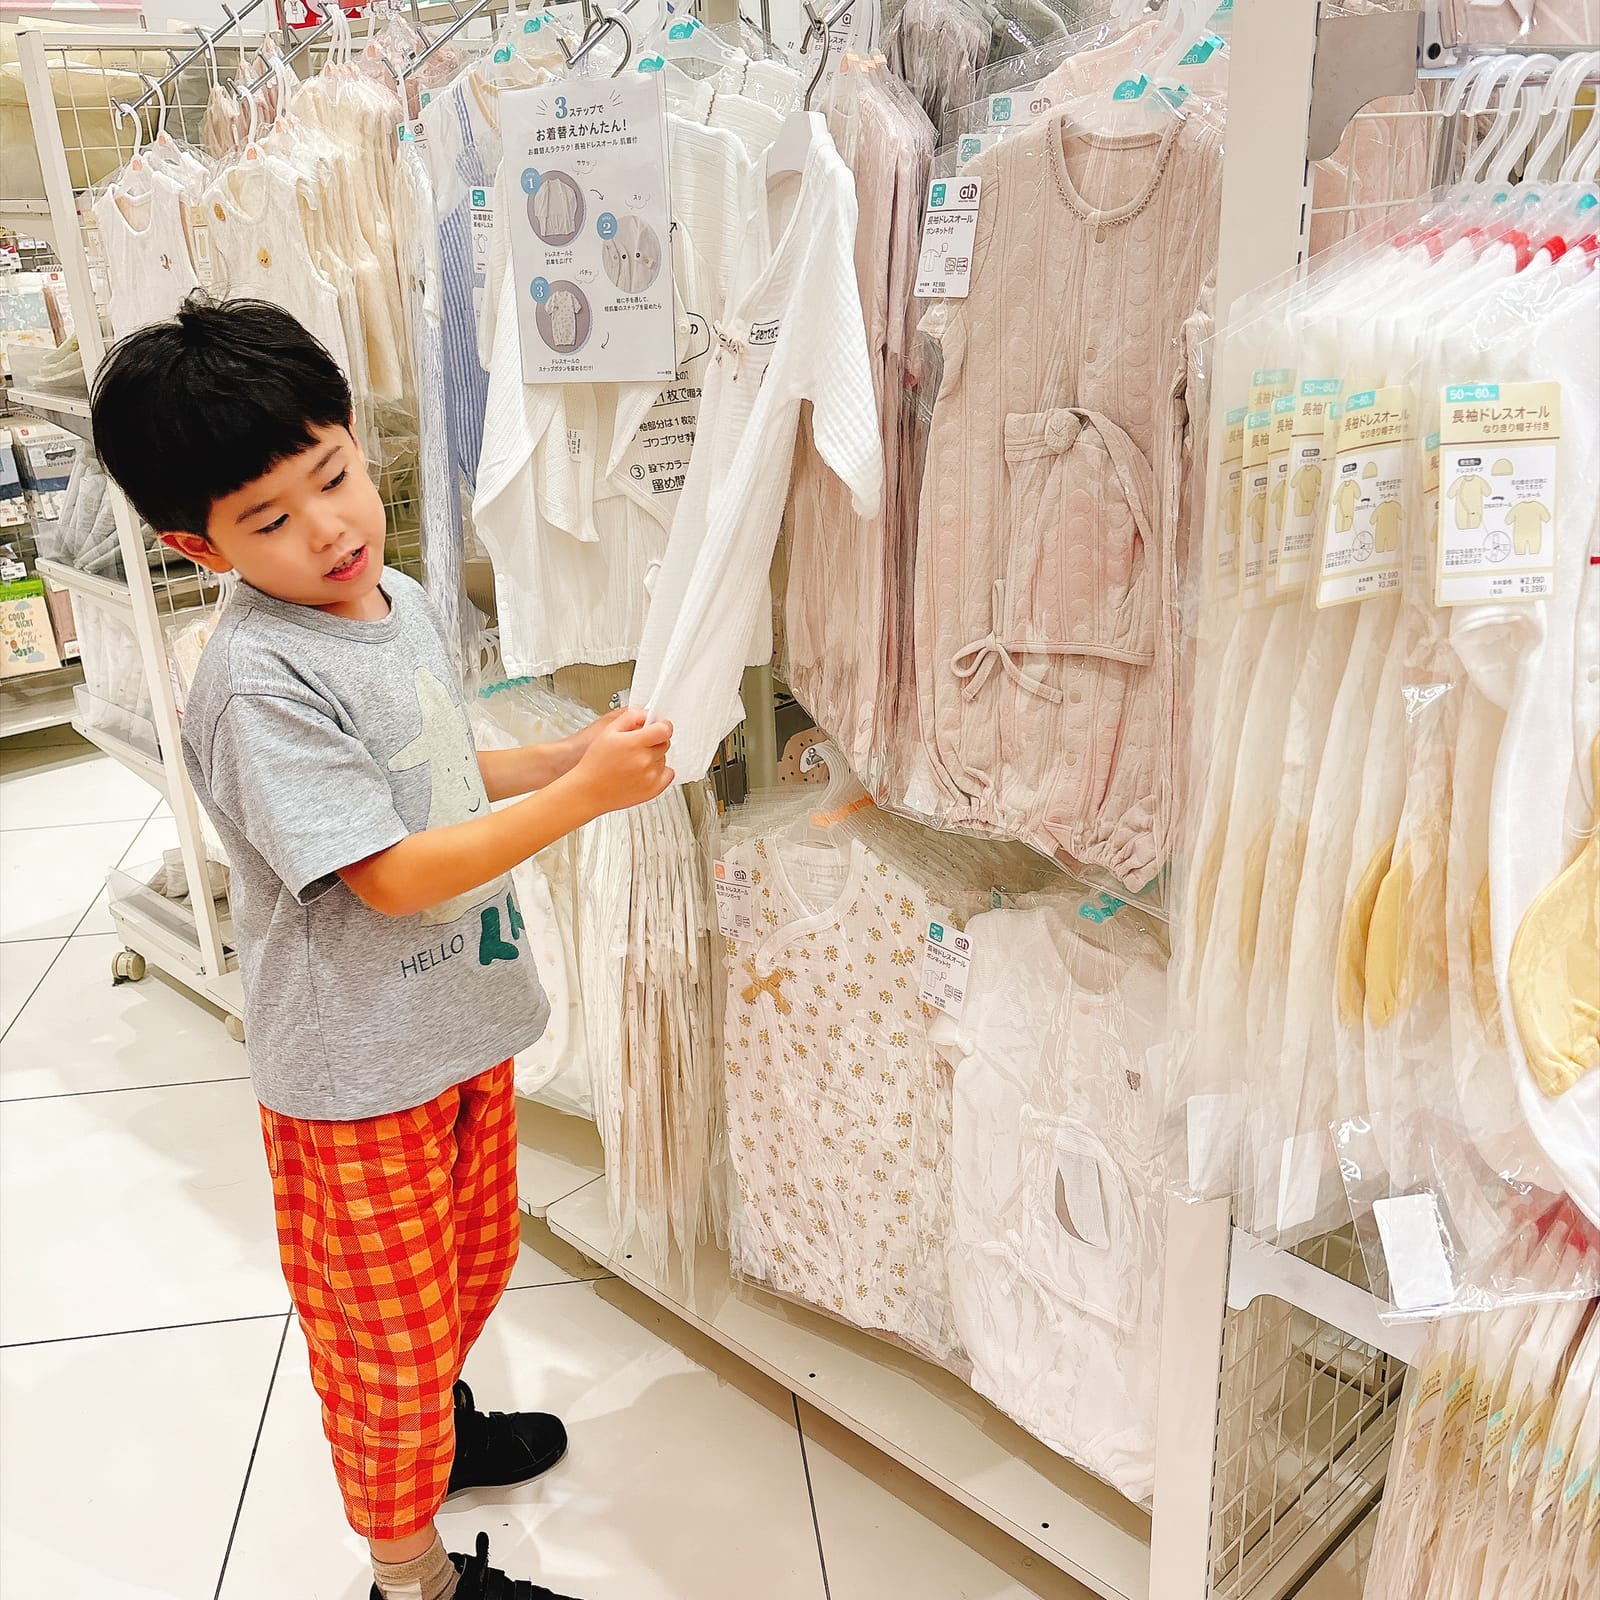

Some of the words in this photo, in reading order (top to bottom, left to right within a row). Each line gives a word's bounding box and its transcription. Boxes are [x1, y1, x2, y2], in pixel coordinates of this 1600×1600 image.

[554, 96, 605, 119] 3ステップで
[959, 183, 978, 200] ah
[1451, 405, 1551, 424] 長袖ドレスオール
[400, 934, 465, 979] HELLO
